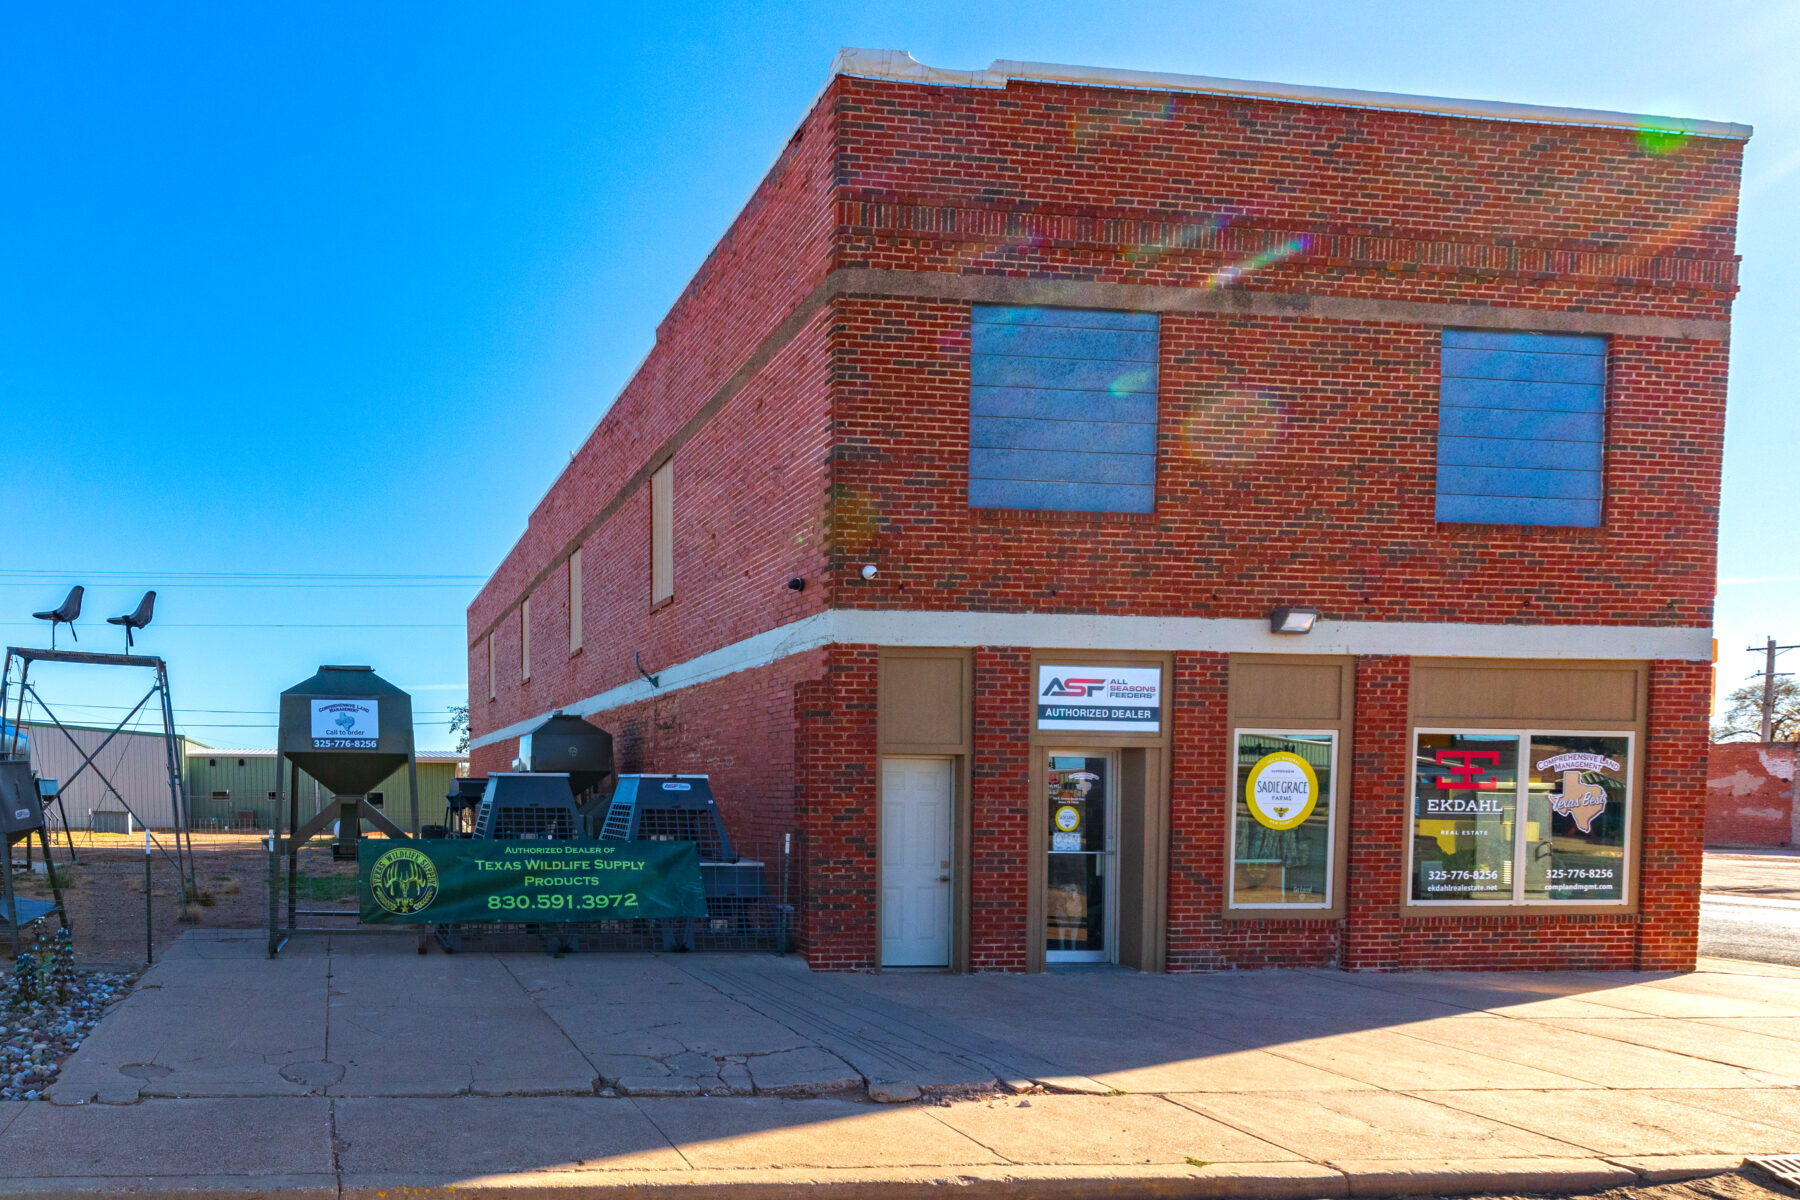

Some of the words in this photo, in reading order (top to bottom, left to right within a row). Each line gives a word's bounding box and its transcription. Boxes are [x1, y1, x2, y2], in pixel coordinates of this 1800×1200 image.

[1041, 677, 1106, 697] ASF
[1045, 708, 1109, 718] AUTHORIZED
[1111, 709, 1151, 719] DEALER
[314, 739, 377, 748] 325-776-8256
[1538, 753, 1598, 769] COMPREHENSIVE
[1599, 756, 1620, 771] LAND
[1555, 761, 1602, 771] MANAGEMENT
[1582, 791, 1607, 806] Best
[1427, 799, 1503, 812] EKDAHL
[385, 851, 419, 861] WILDLIFE
[421, 859, 436, 884] SUPPLY
[475, 860, 522, 870] TEXAS
[524, 859, 591, 870] WILDLIFE
[594, 859, 645, 870] SUPPLY
[1428, 870, 1498, 880] 325-776-8256
[1545, 869, 1613, 879] 325-776-8256
[524, 876, 600, 887] PRODUCTS
[1544, 883, 1613, 891] complandmgmt.com
[1427, 884, 1498, 892] ekdahlrealestate.net
[487, 893, 639, 910] 830.591.3972
